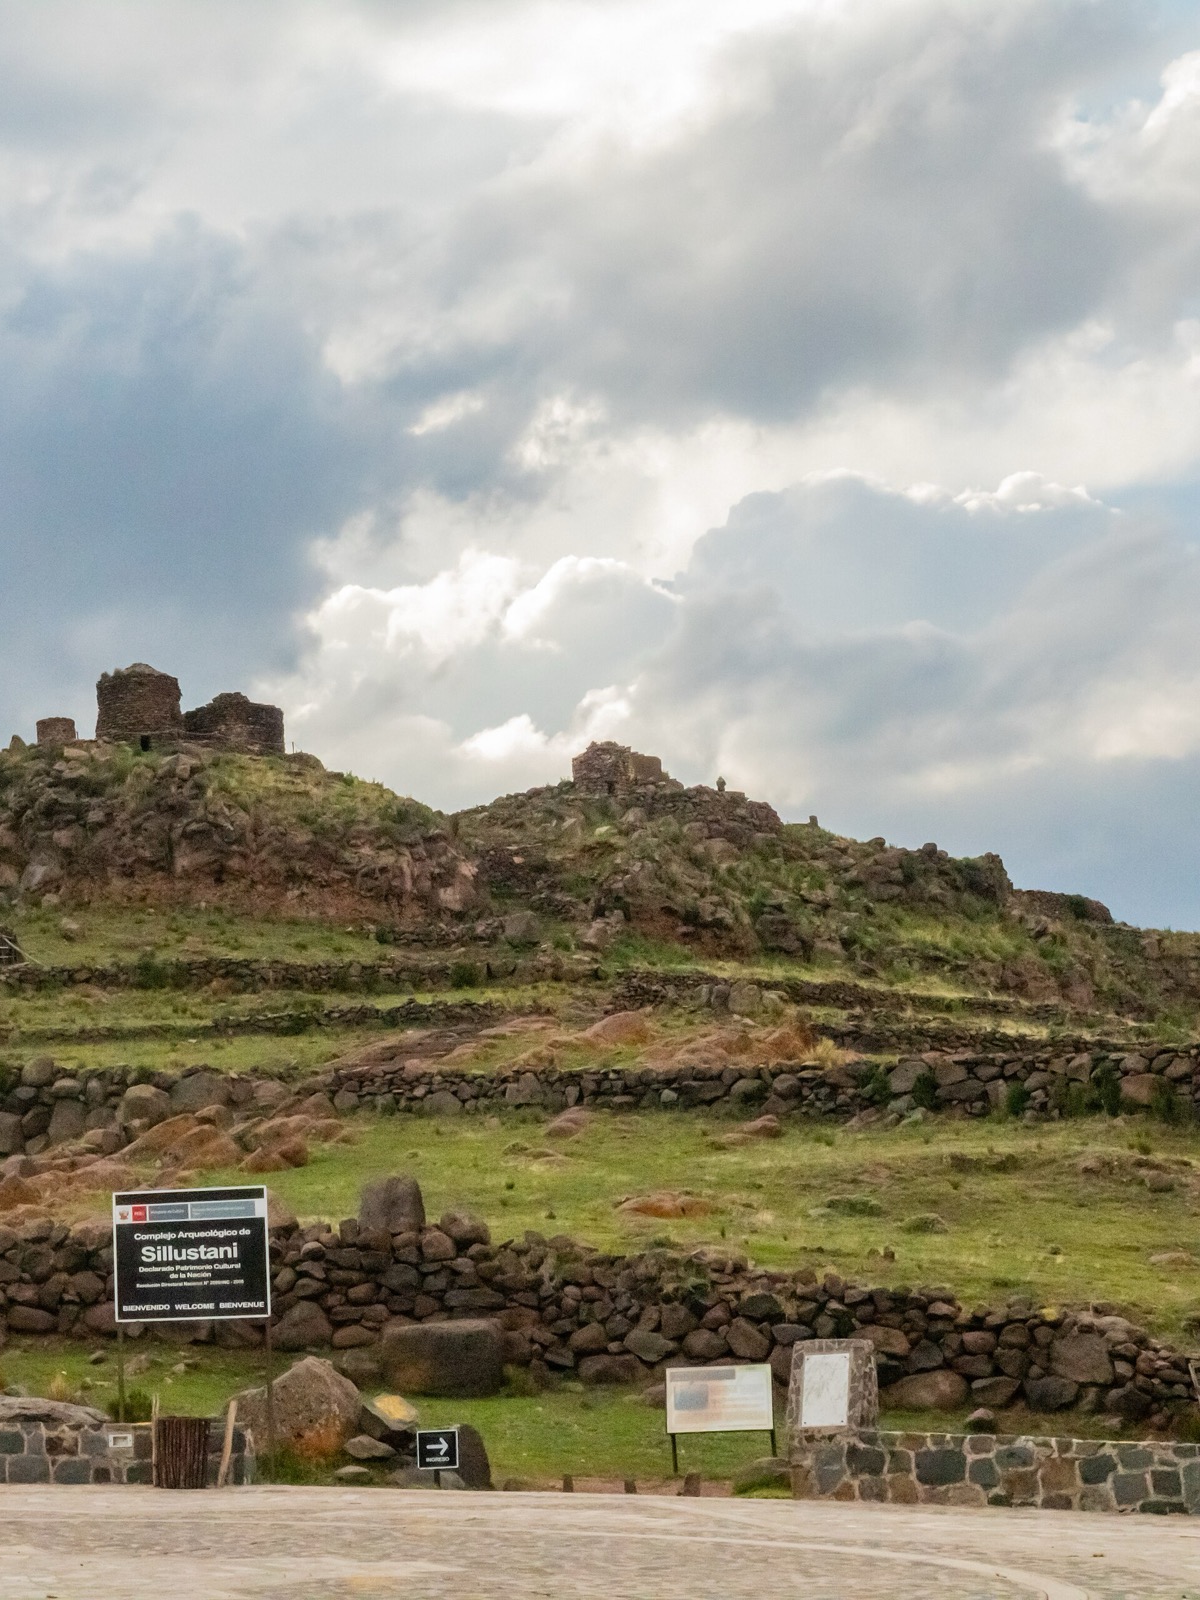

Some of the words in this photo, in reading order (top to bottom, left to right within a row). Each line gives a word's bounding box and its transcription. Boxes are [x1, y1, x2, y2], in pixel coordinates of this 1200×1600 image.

[134, 1231, 176, 1241] Complejo
[178, 1228, 237, 1239] Arqueológico
[141, 1242, 238, 1262] Sillustani
[138, 1265, 174, 1273] Declarado
[213, 1262, 241, 1270] Cultural
[122, 1304, 170, 1312] BIENVENIDO
[219, 1301, 265, 1309] BIENVENUE
